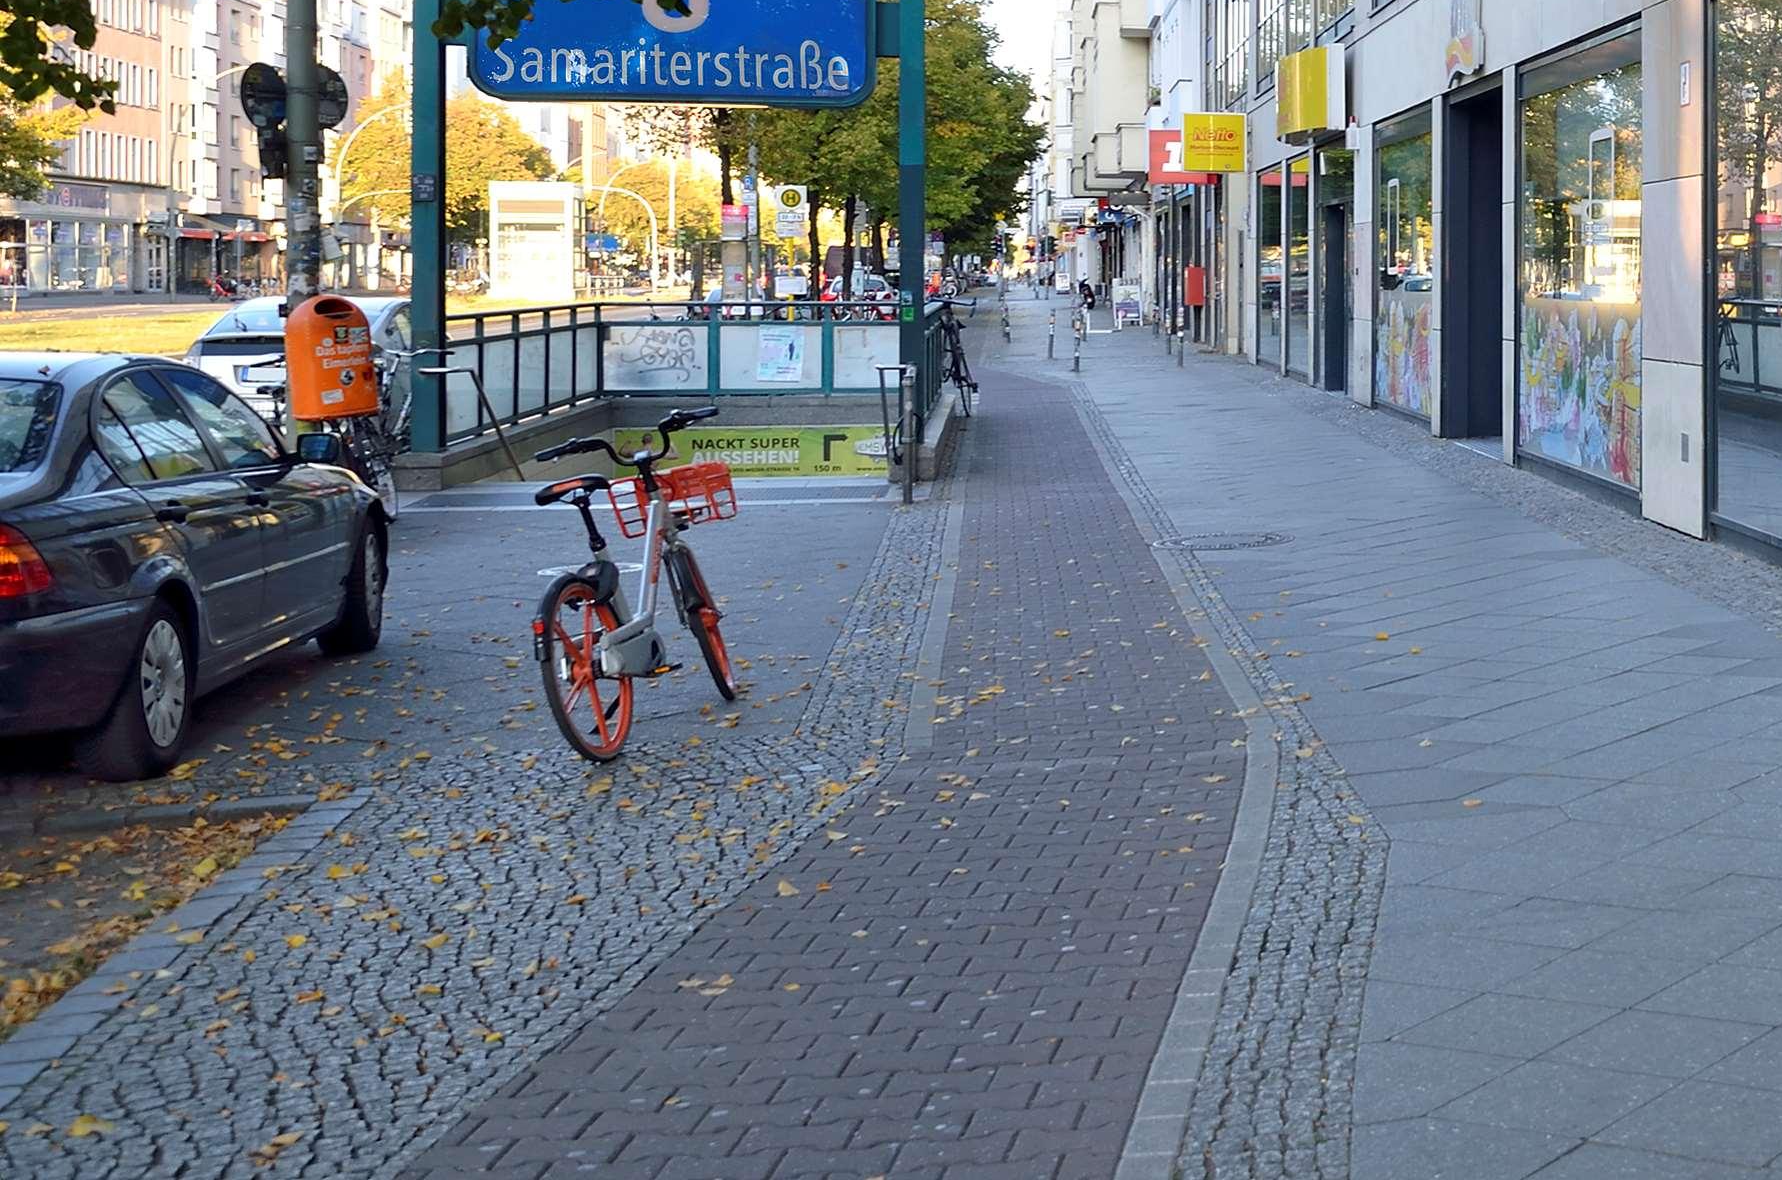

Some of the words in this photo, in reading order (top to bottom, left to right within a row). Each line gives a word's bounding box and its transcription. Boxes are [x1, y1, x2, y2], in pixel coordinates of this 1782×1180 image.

[492, 37, 850, 92] Samariterstraße
[691, 438, 745, 450] NACKT
[750, 437, 800, 449] SUPER
[691, 450, 800, 465] AUSSEHEN!
